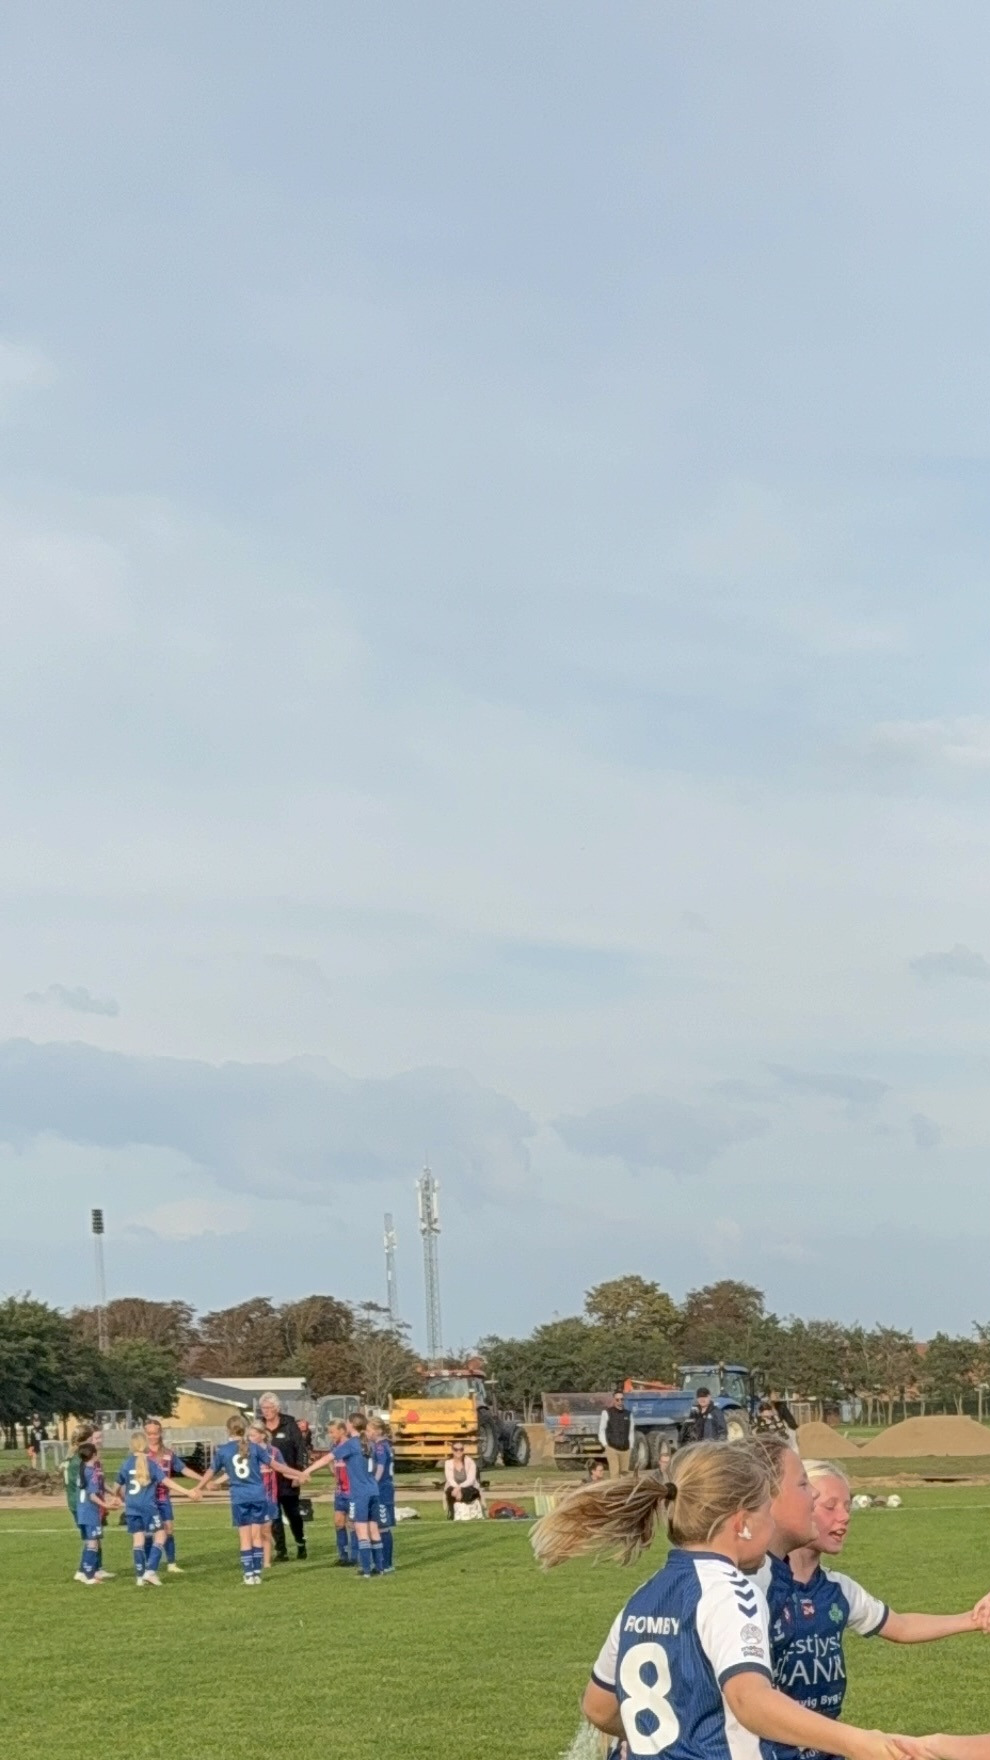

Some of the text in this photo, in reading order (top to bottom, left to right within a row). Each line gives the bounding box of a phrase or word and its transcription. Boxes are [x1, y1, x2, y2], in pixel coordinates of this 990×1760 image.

[232, 1454, 250, 1479] 8
[623, 1615, 680, 1635] ROMBY
[787, 1631, 841, 1660] stjys
[780, 1654, 846, 1687] ANK
[620, 1642, 680, 1756] 8
